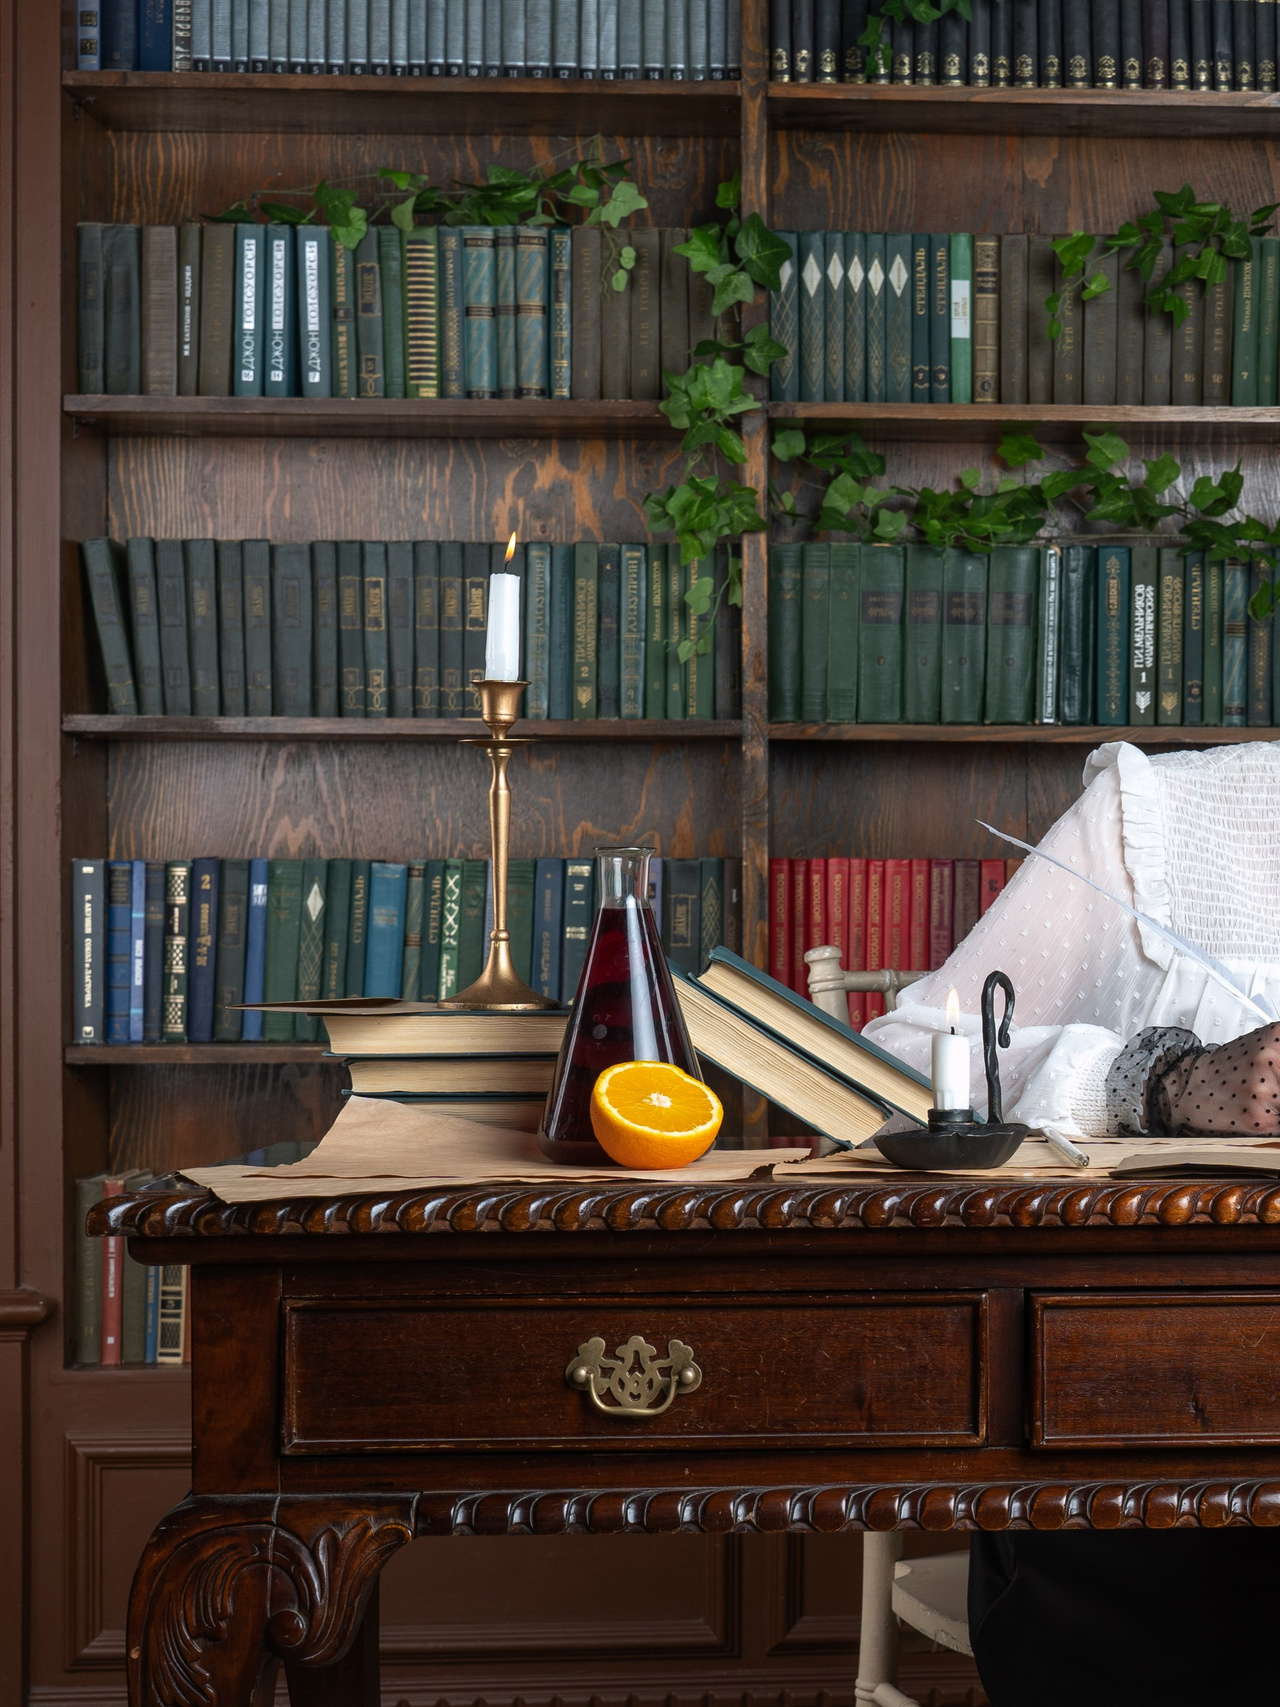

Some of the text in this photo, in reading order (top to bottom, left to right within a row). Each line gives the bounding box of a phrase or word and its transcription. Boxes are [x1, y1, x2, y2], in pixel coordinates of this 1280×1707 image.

[244, 242, 256, 323] ГОЛСУОРСИ
[274, 242, 285, 324] ГОЛСУОРСИ
[306, 245, 318, 325] ГОЛСУОРСИ
[916, 248, 926, 315] СТЕНДАЛЬ
[937, 248, 946, 315] СТЕНДАЛЬ
[242, 330, 255, 369] ДЖОН
[272, 330, 284, 369] ДЖОН
[308, 331, 321, 370] ДЖОН
[653, 561, 662, 606] ШОЛОХОВ
[1191, 563, 1202, 630] СТЕНДАЛЬ
[576, 578, 587, 641] МЕЛЬНИКОВ
[1134, 584, 1146, 648] МЕЛЬНИКОВ
[1163, 575, 1173, 642] МЕЛЬНИКОВ
[581, 666, 589, 678] 2
[1140, 672, 1147, 683] 1
[201, 874, 211, 890] 2
[795, 875, 803, 923] ШОЛОХОВ
[812, 874, 821, 923] ШОЛОХОВ
[834, 873, 842, 922] ШОЛОХОВ
[854, 874, 862, 923] ШОЛОХОВ
[893, 875, 901, 924] ШОЛОХОВ
[915, 874, 923, 923] ШОЛОХОВ
[353, 875, 364, 943] СТЕНДАЛЬ
[429, 875, 441, 944] СТЕНДАЛЬ
[776, 873, 785, 969] МИХАИЛ ШОЛОХОВ
[870, 874, 880, 969] МИХАИЛ ШОЛОХОВ
[84, 937, 92, 962] СОКОЛ
[84, 969, 92, 1008] ЛАСТОЧКА
